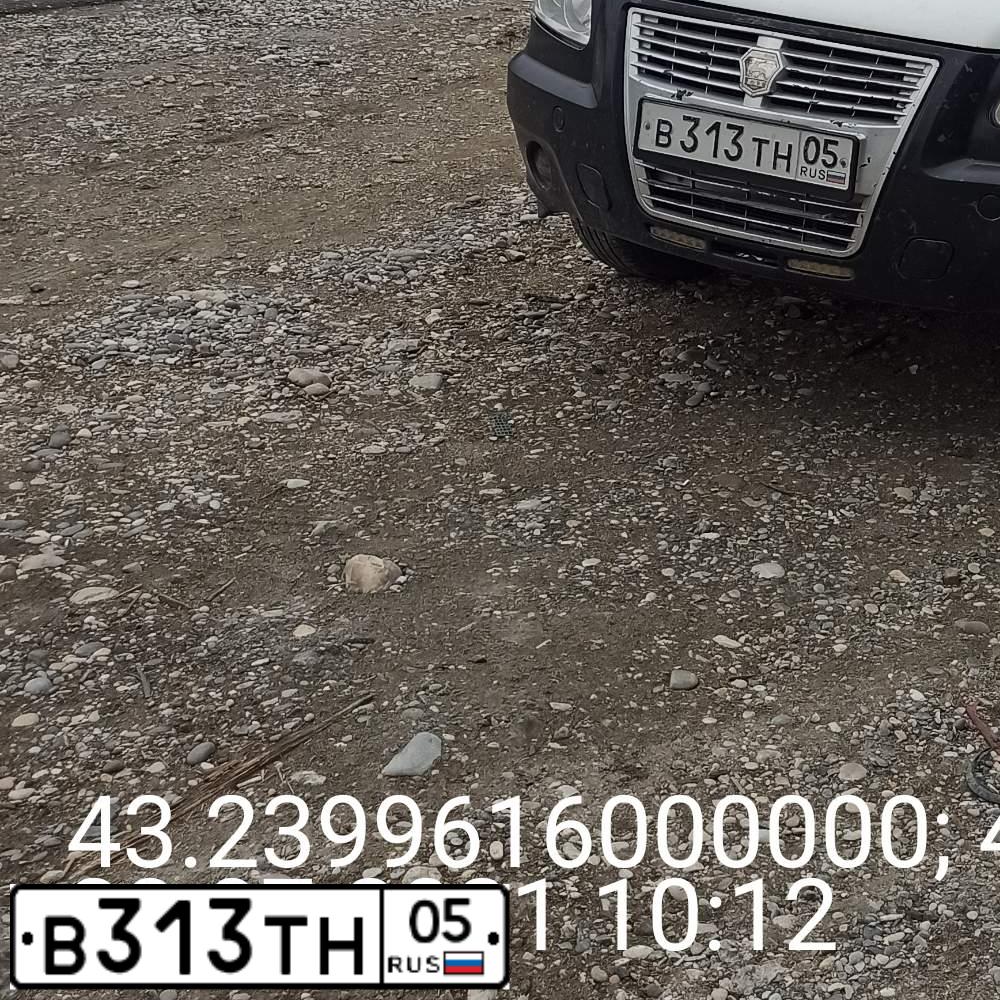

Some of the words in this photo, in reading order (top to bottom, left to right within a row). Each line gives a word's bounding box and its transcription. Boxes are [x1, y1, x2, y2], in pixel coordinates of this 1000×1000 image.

[654, 114, 794, 173] В313ТН
[802, 135, 840, 169] 05
[799, 166, 826, 180] RUS
